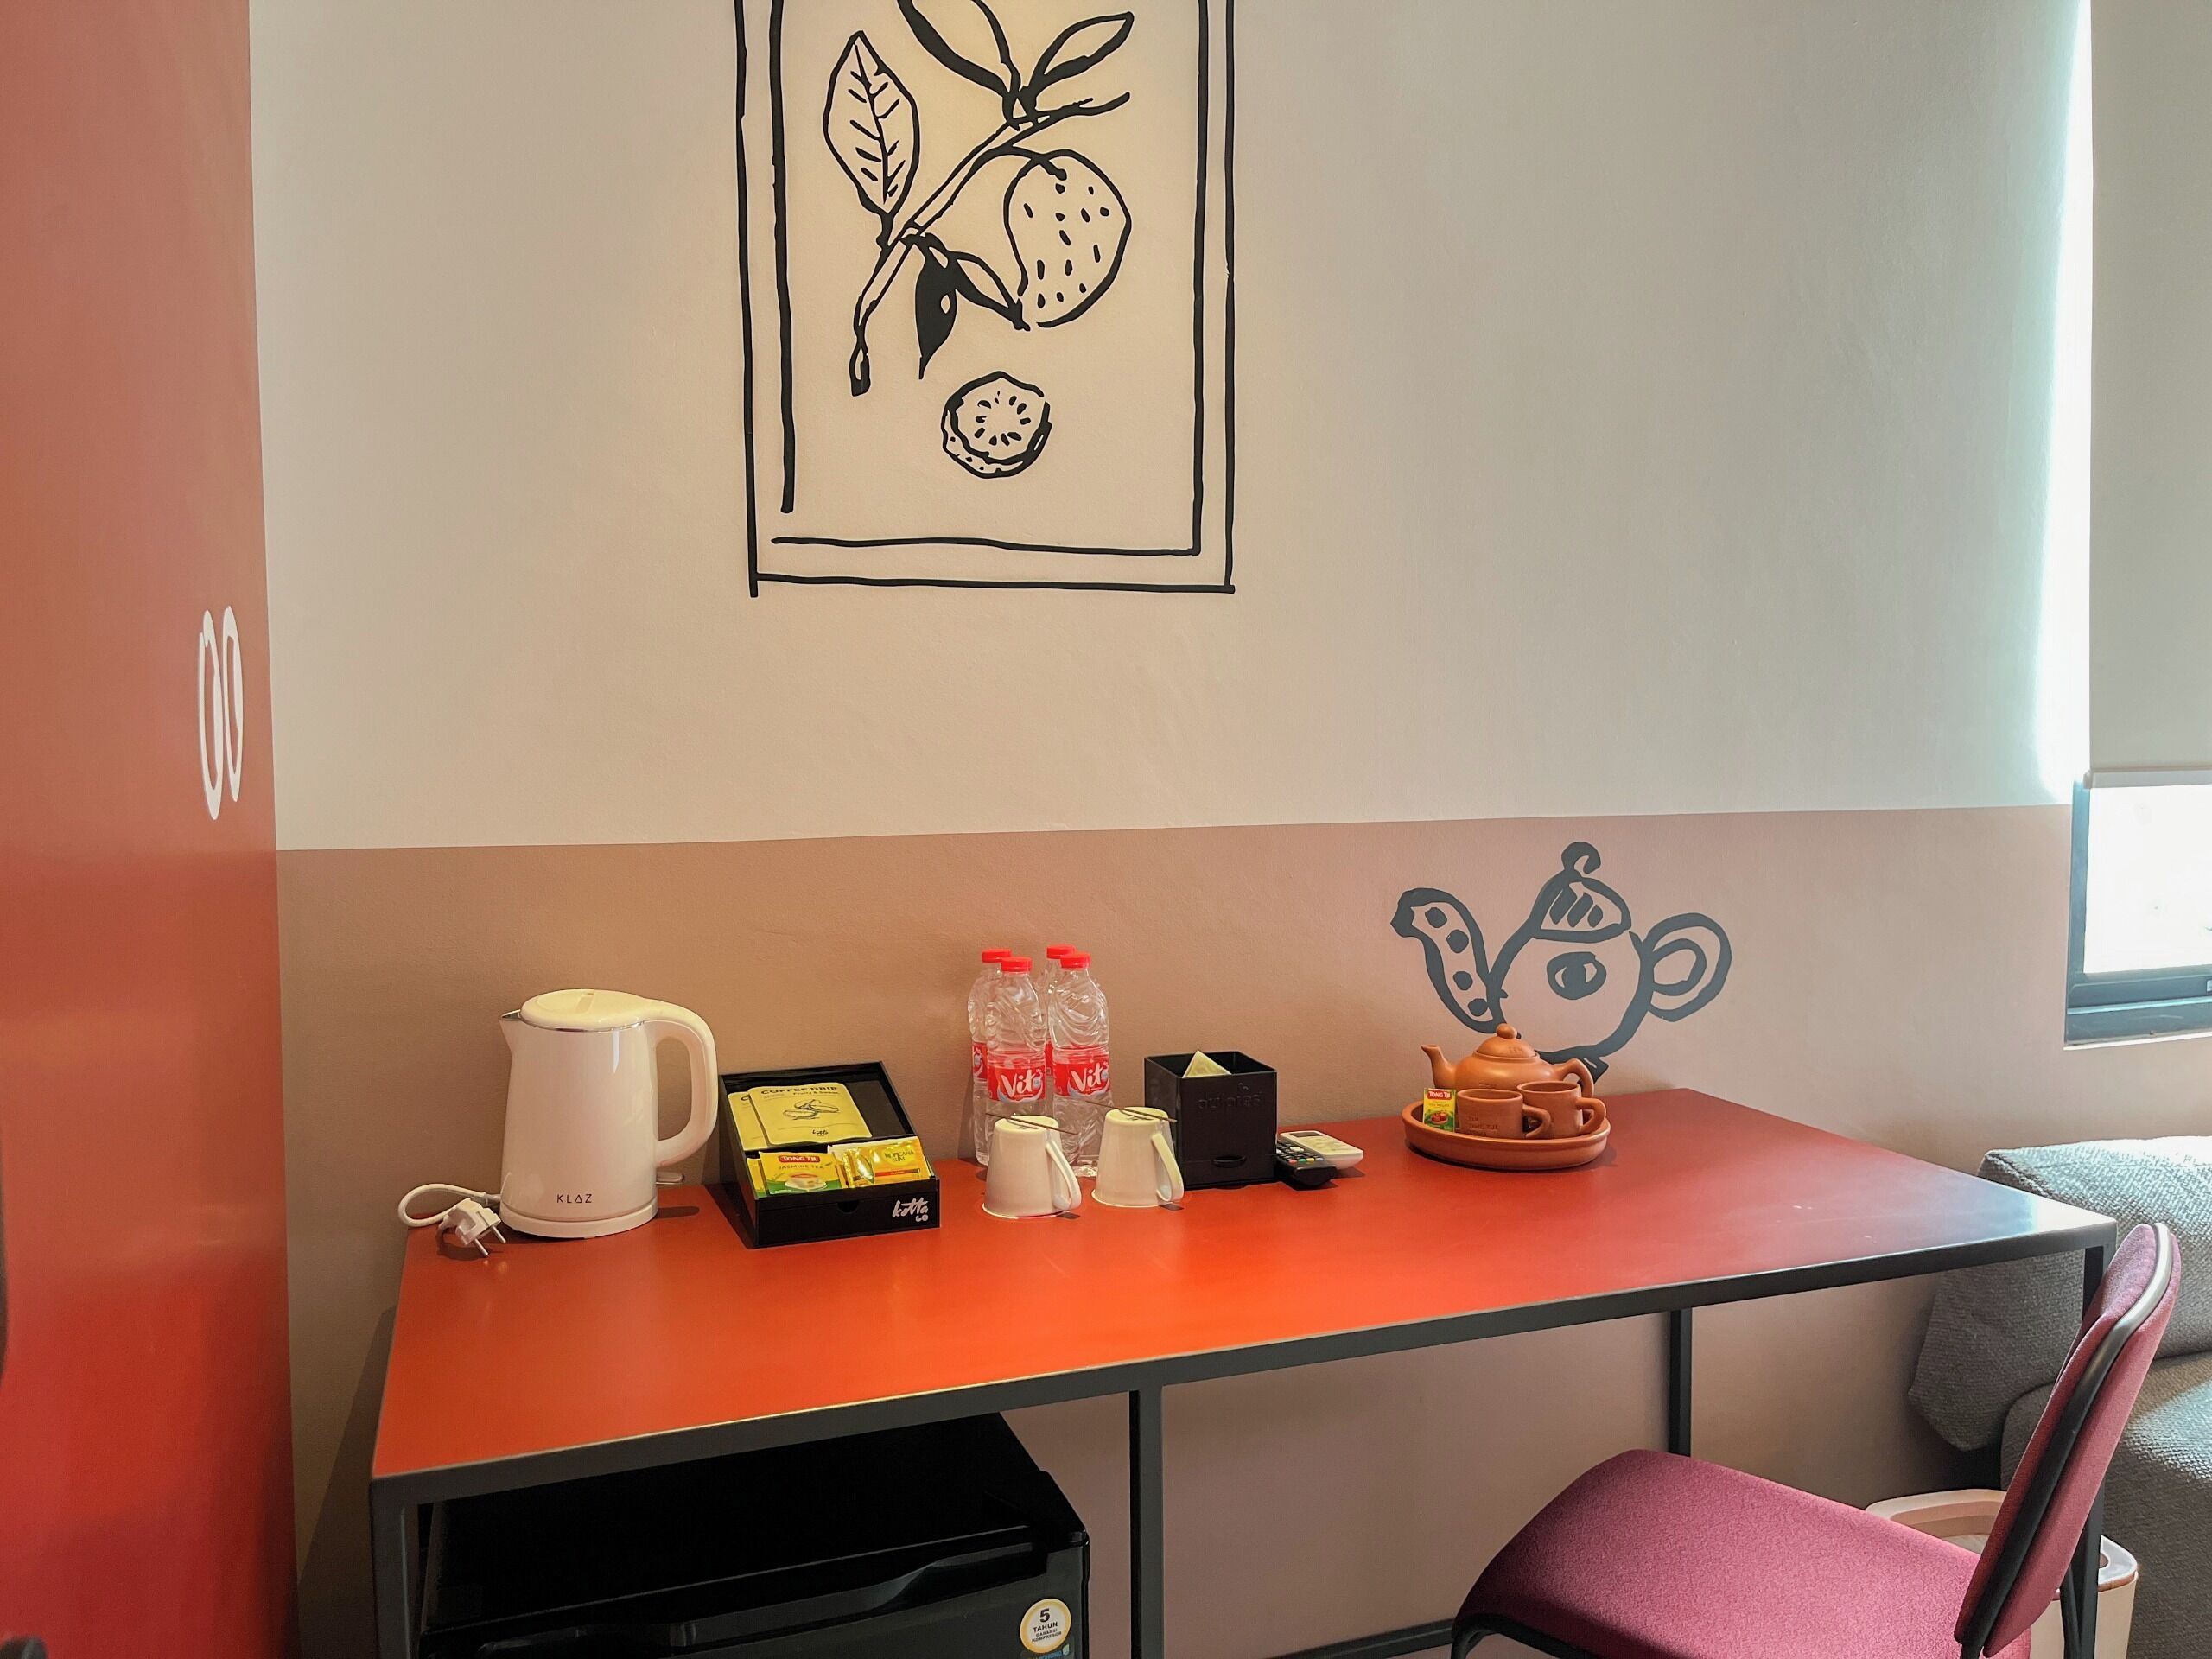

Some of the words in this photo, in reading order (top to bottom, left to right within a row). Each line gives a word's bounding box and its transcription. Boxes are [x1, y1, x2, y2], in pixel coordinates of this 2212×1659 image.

[1039, 1607, 1050, 1623] 5
[1033, 1622, 1058, 1632] TAHUN
[1035, 1628, 1058, 1637] GARANSI
[1032, 1631, 1061, 1643] KOMPRESOR
